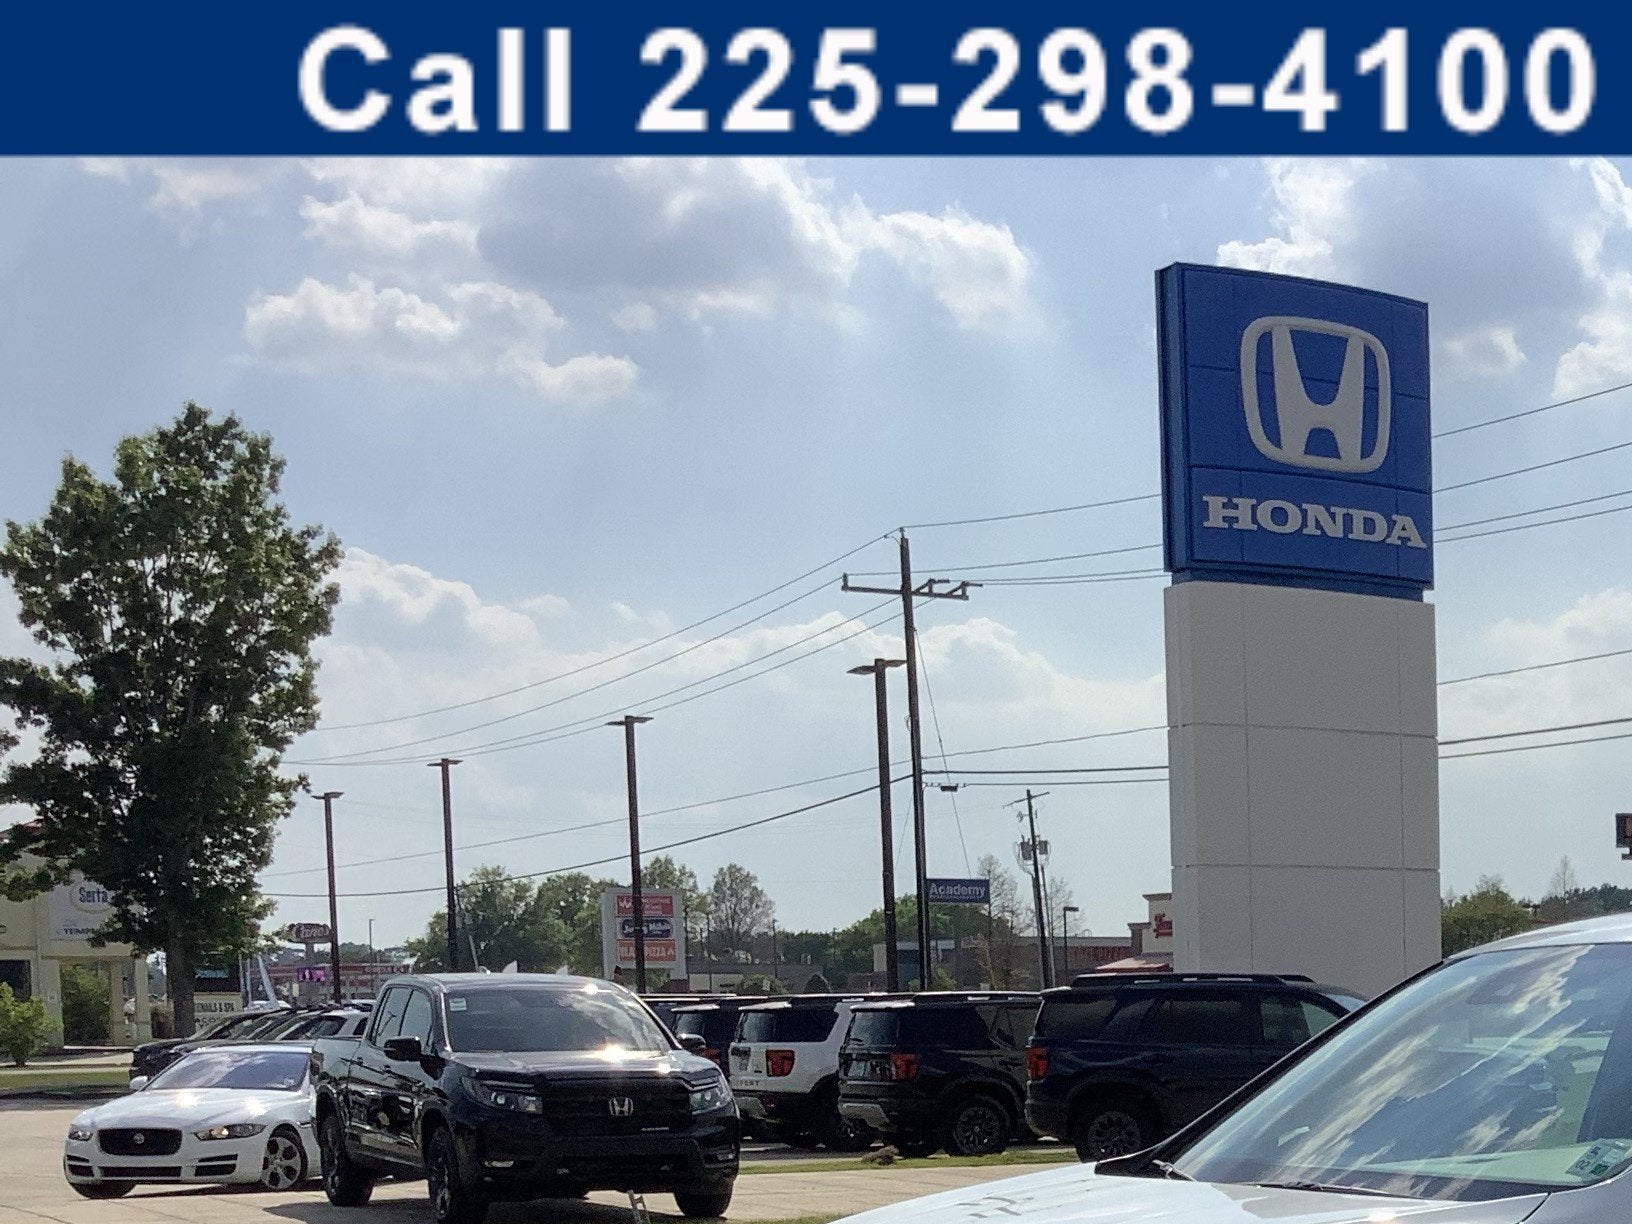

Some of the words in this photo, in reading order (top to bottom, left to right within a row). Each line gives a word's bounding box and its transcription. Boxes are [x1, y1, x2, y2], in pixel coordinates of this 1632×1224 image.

[1202, 495, 1427, 549] HONDA
[78, 886, 109, 904] Serta
[929, 882, 986, 899] Academy
